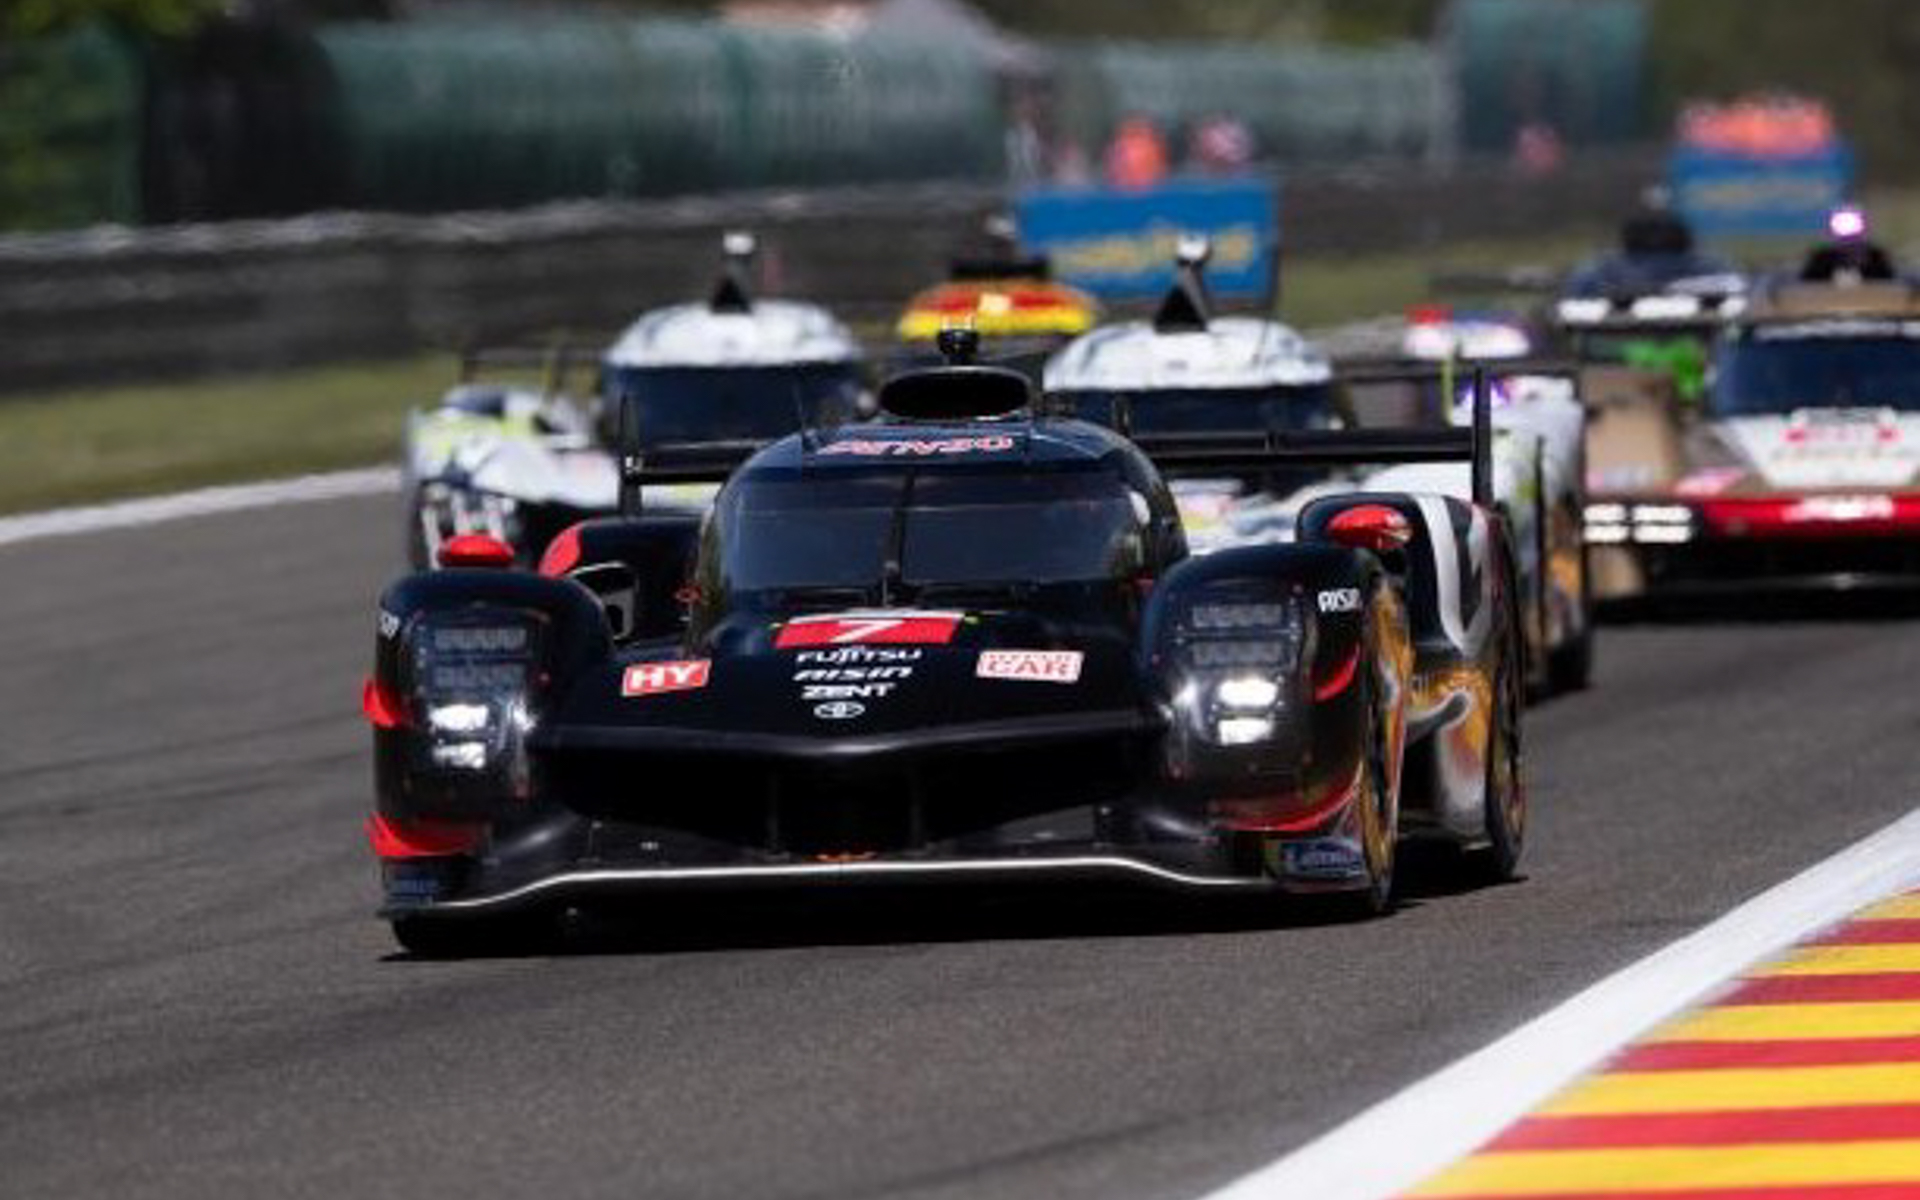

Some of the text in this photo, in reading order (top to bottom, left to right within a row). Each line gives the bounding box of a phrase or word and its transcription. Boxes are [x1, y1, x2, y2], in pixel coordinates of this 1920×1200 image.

[830, 619, 903, 643] 7
[796, 646, 923, 663] FUJITSU
[631, 663, 703, 690] HY
[793, 667, 912, 681] AISIN
[987, 660, 1076, 676] CAR
[802, 682, 897, 699] ZENT
